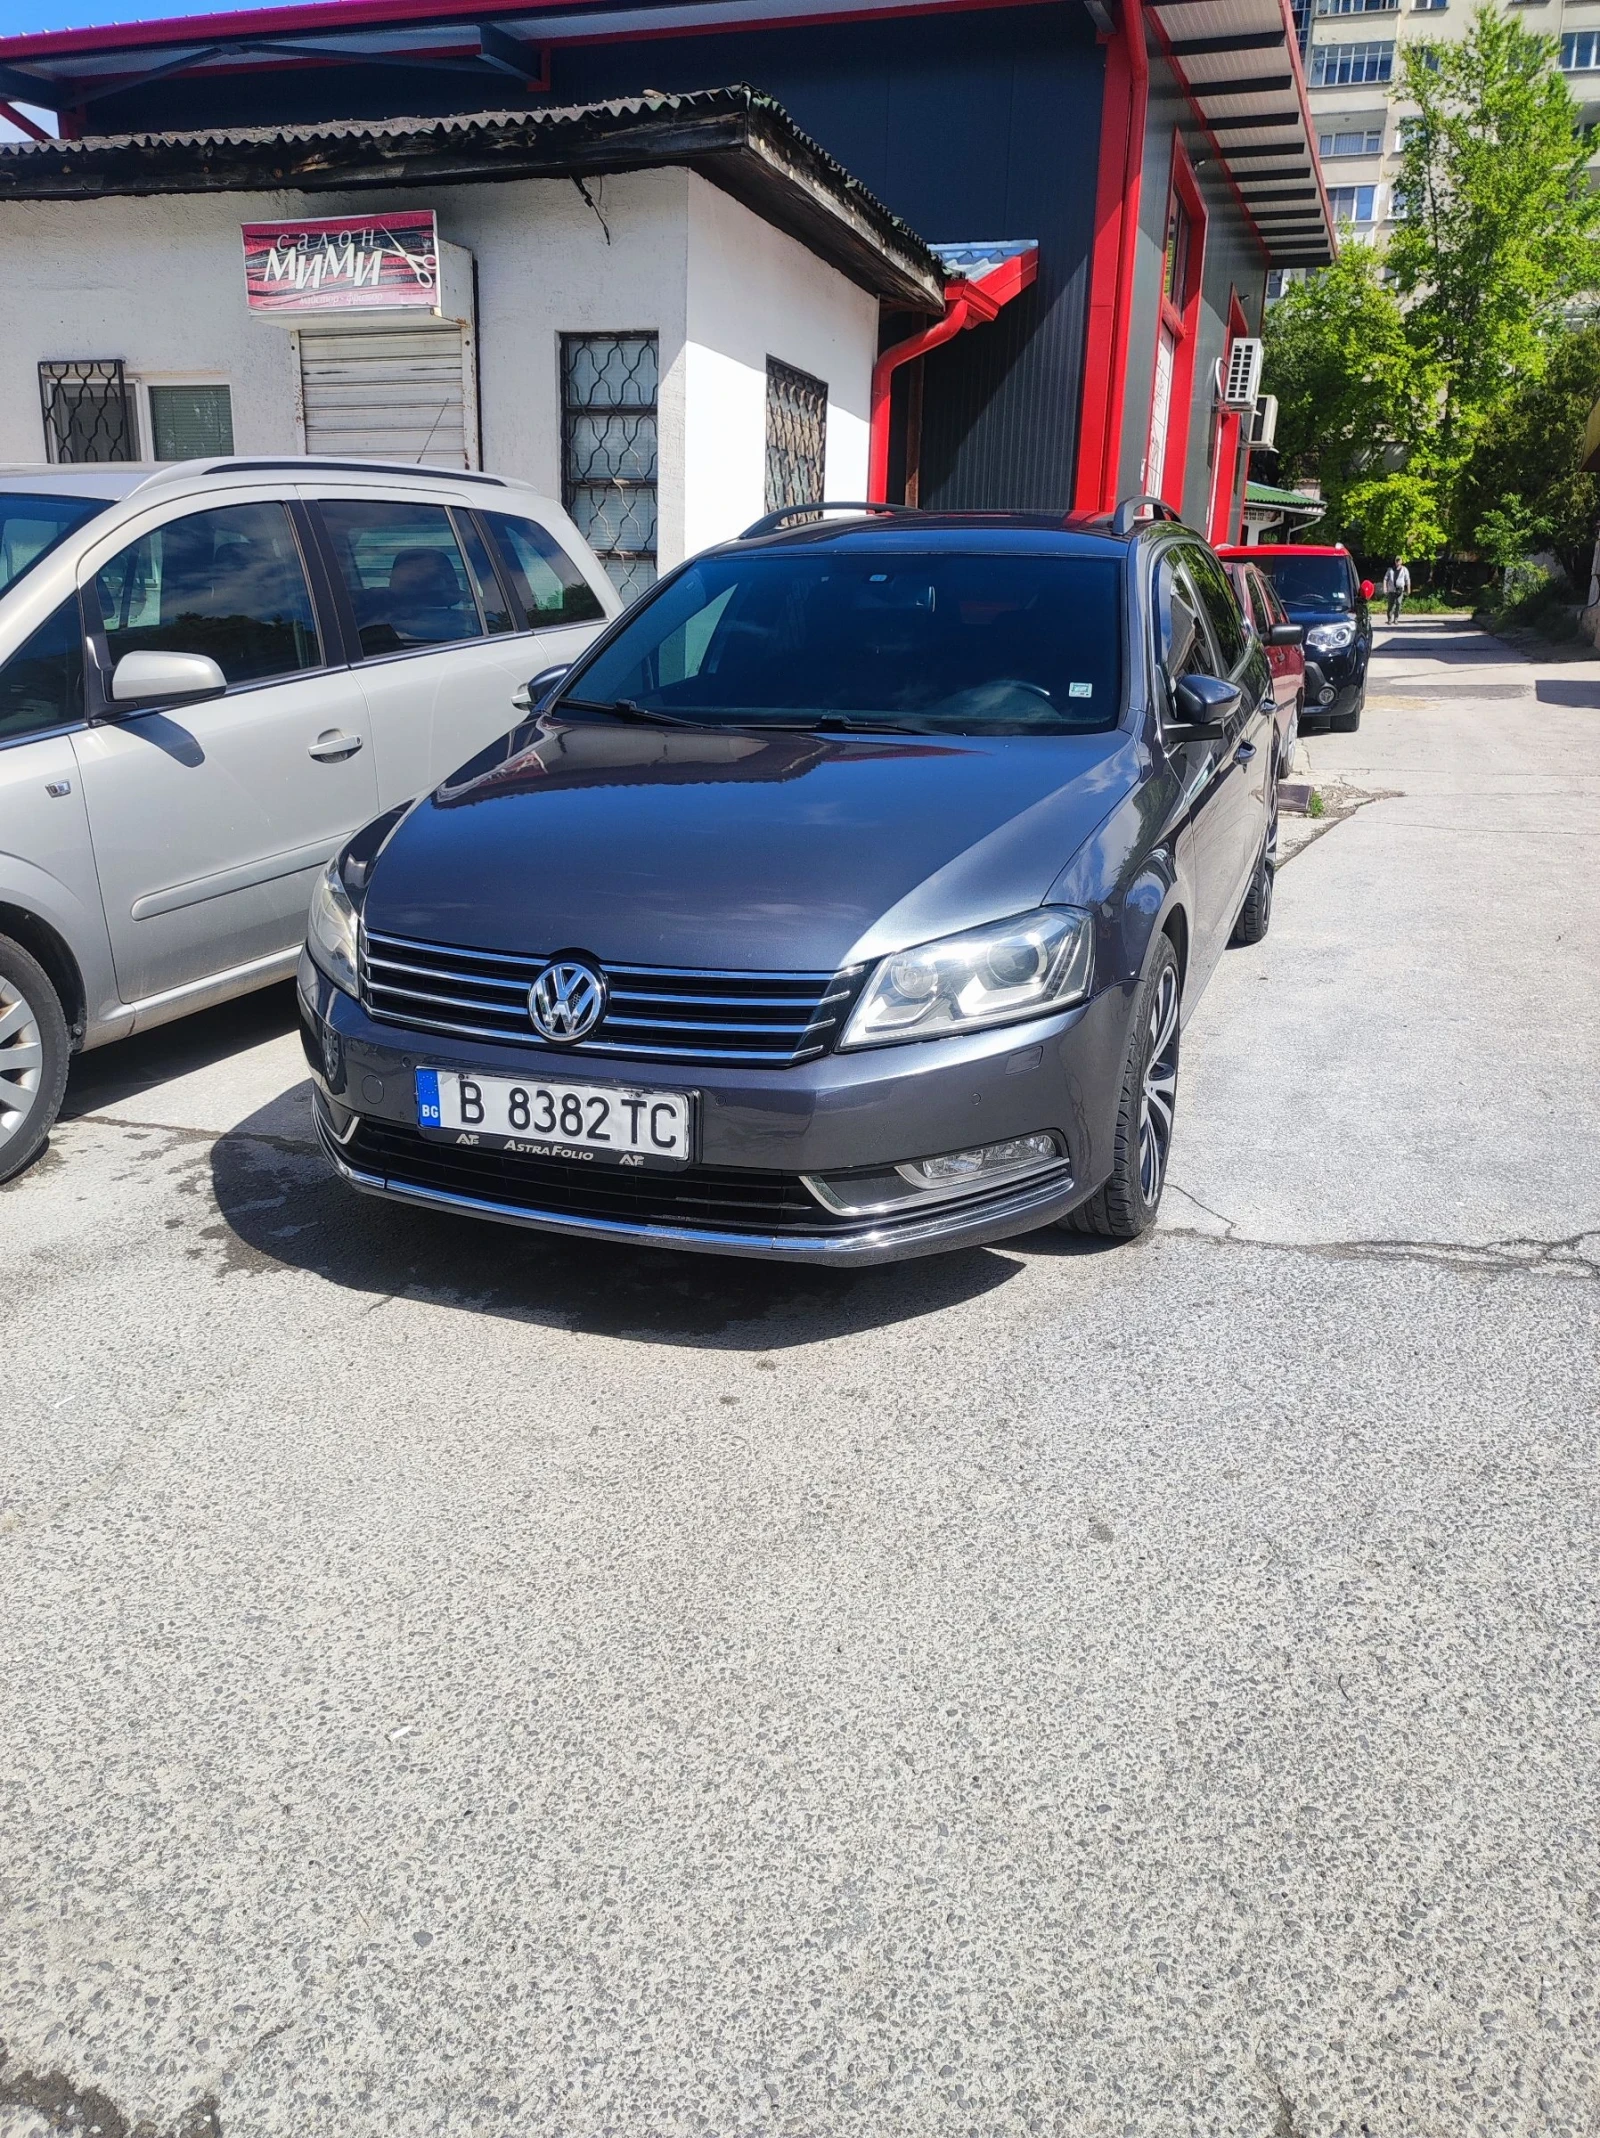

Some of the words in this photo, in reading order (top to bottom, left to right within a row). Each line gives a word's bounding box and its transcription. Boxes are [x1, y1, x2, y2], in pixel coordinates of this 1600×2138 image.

[533, 966, 597, 1037] VW
[421, 1104, 440, 1119] BG
[459, 1080, 485, 1125] B
[507, 1087, 611, 1142] 8382
